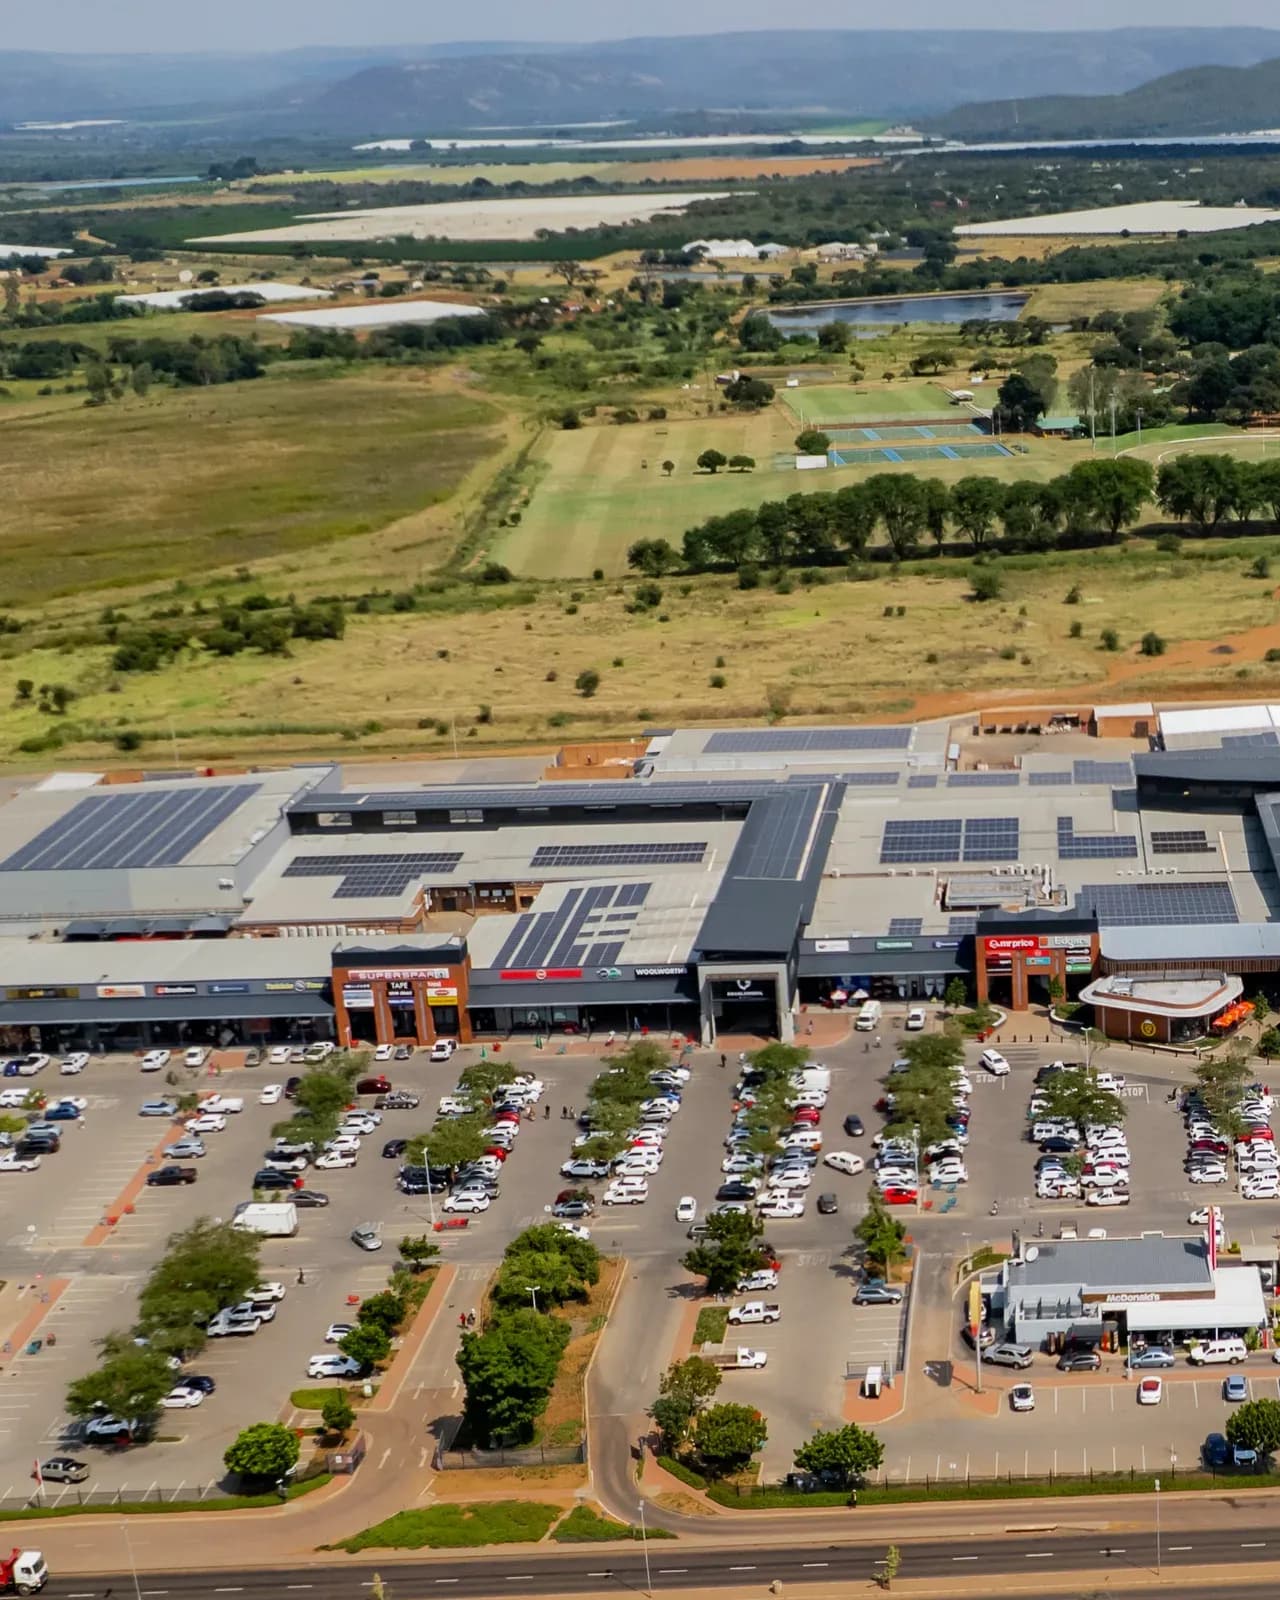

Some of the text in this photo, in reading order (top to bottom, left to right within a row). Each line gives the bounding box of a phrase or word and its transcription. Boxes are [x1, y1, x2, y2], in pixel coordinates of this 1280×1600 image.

[358, 971, 434, 980] SUPERSPAR
[635, 967, 688, 976] WOOLWORTHS
[976, 1074, 998, 1083] STOP
[1121, 1087, 1144, 1096] STOP
[1106, 1292, 1160, 1302] McDonald's
